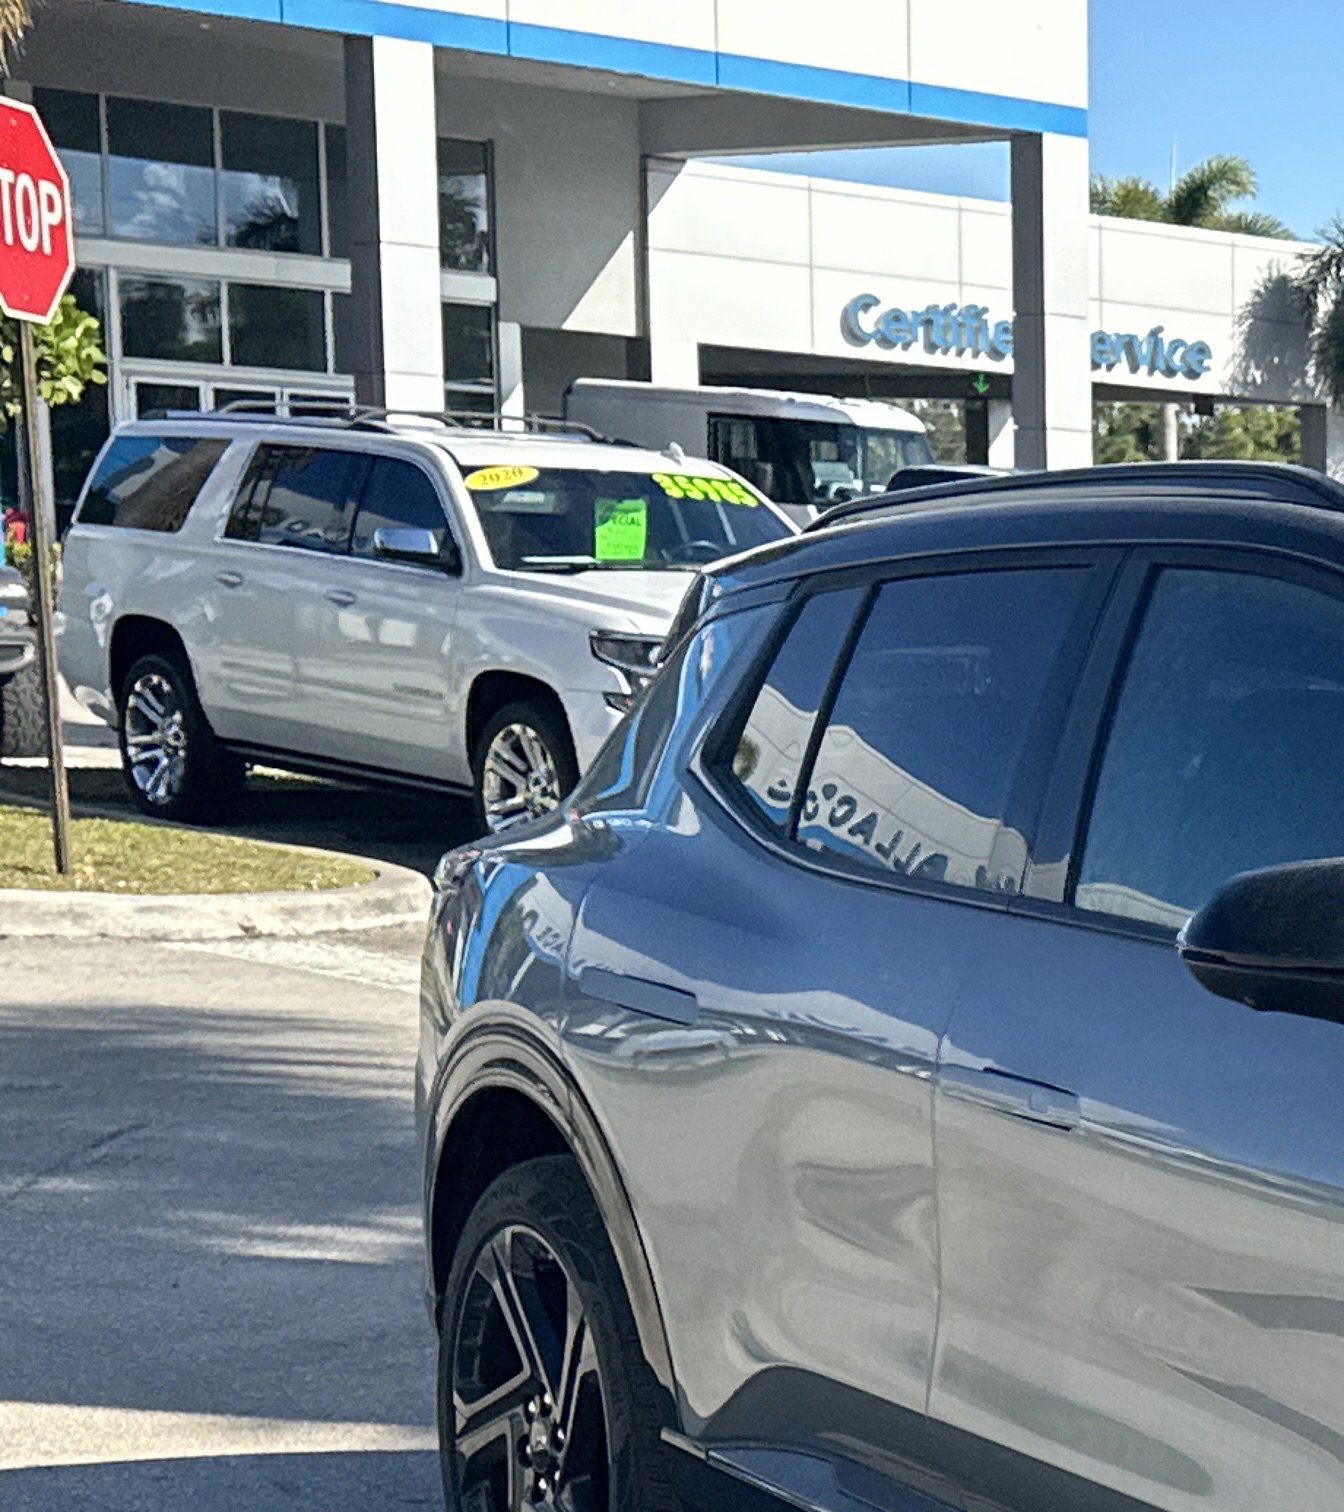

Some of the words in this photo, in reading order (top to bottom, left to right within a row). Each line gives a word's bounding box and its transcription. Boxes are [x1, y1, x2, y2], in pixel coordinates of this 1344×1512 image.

[0, 166, 62, 256] TOP
[840, 293, 1012, 360] Certifie
[1090, 325, 1213, 380] ervice
